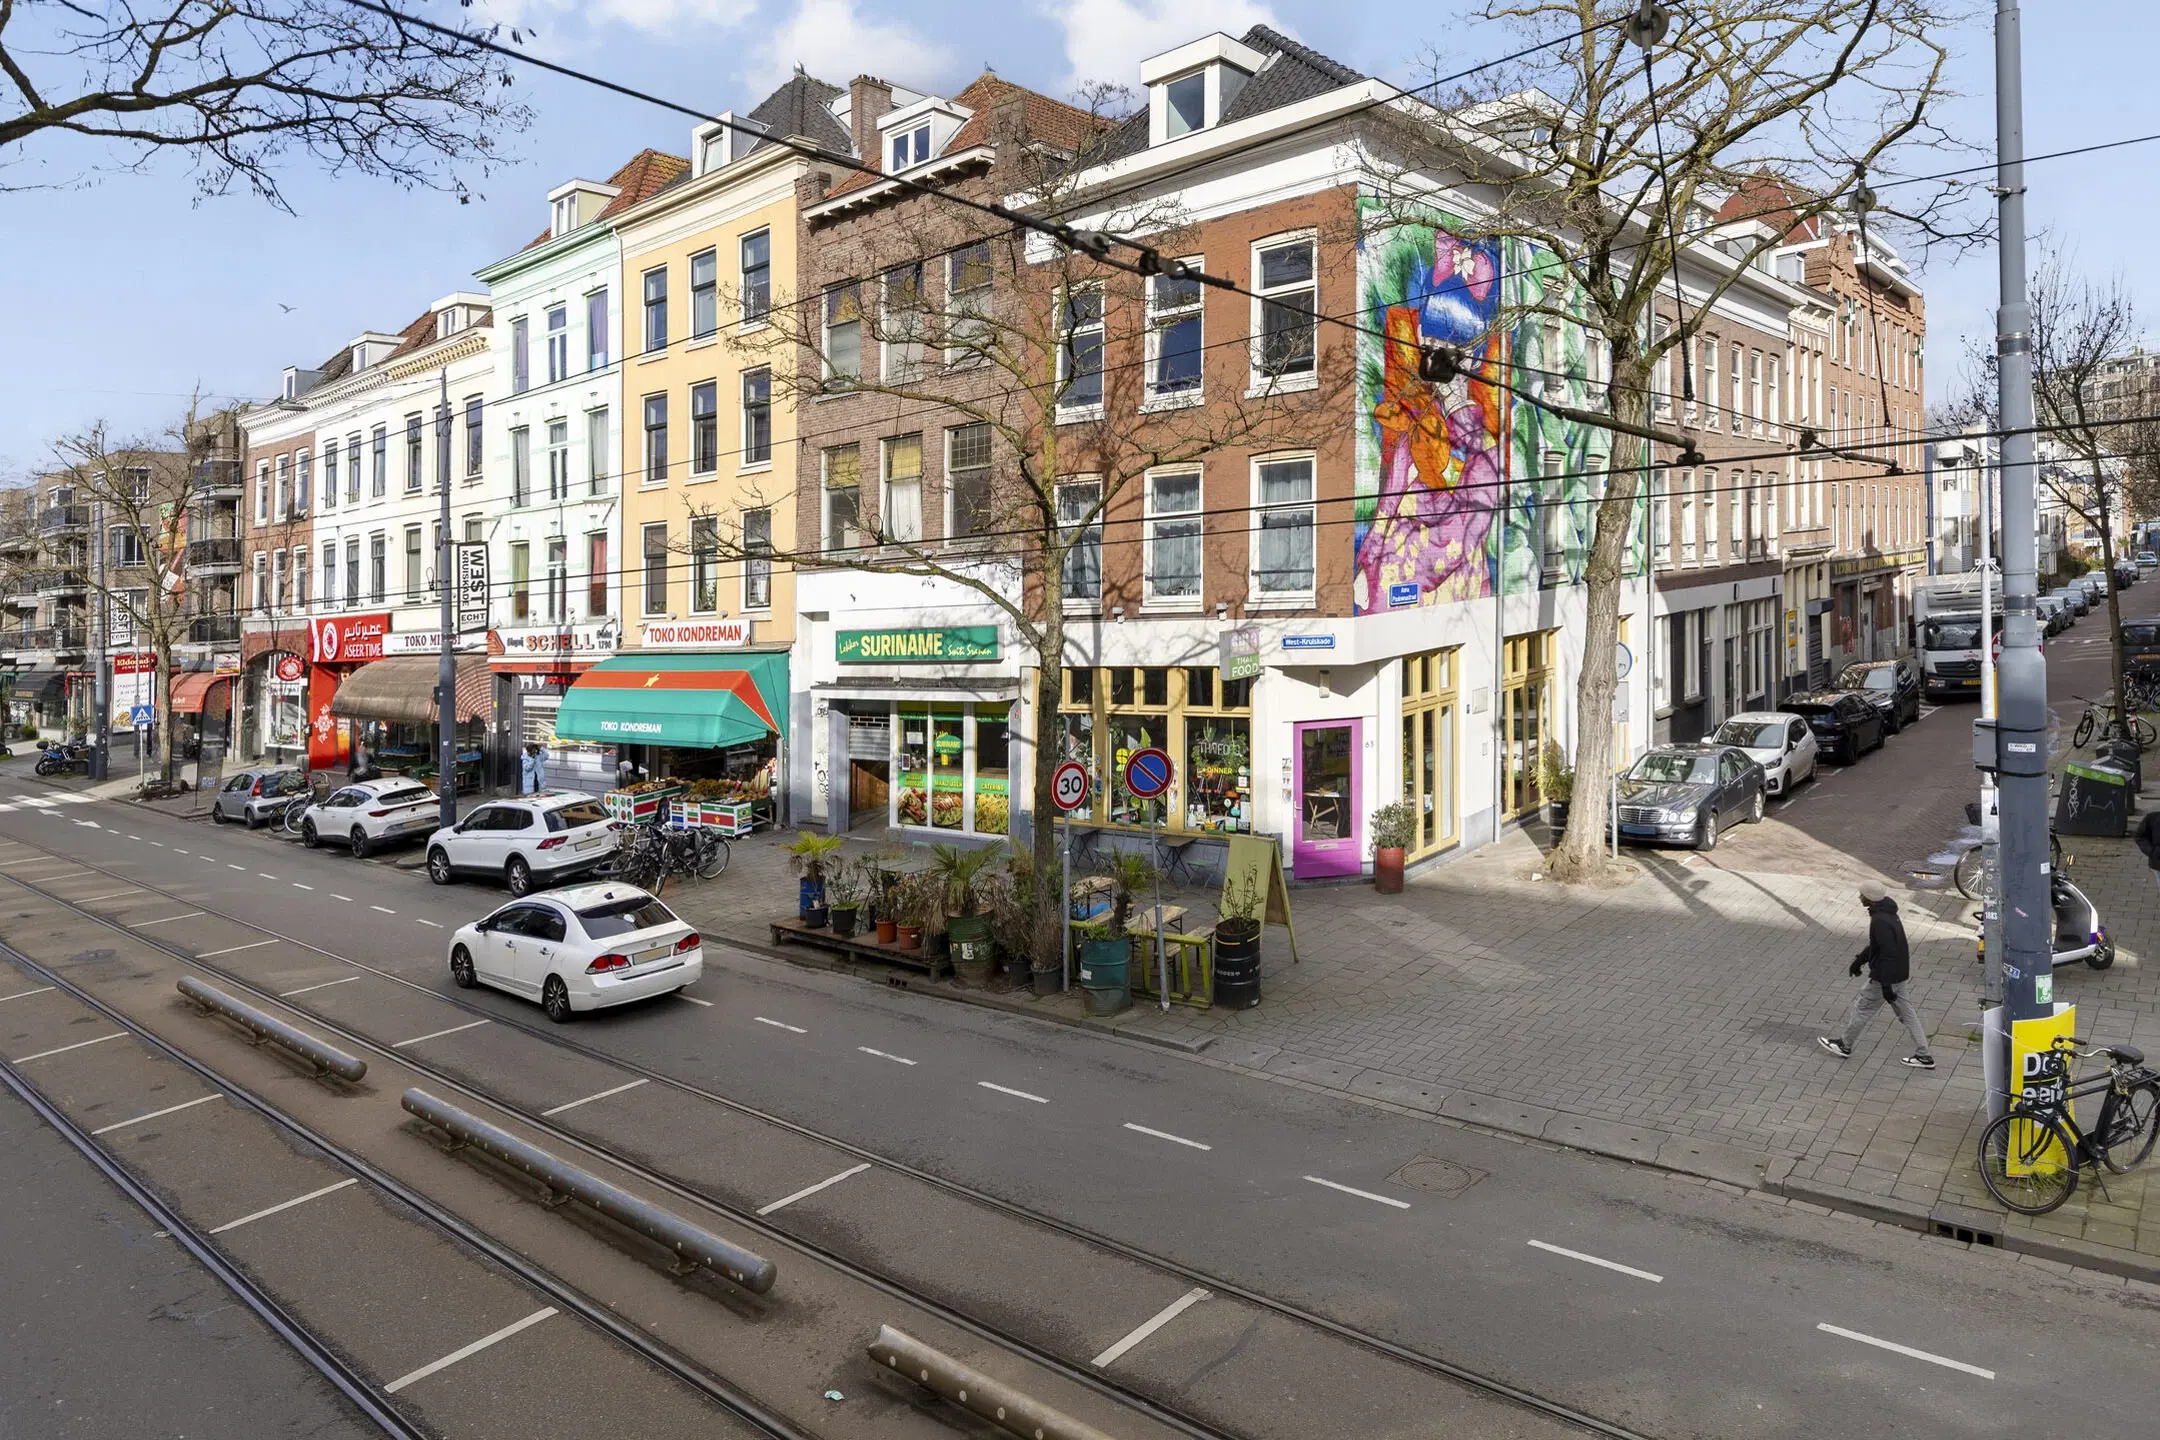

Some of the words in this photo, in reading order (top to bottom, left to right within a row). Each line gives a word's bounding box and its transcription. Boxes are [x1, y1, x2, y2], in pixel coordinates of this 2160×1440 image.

[462, 550, 470, 606] KRUISKADE
[461, 612, 485, 621] ECHT
[404, 635, 427, 647] TOKO
[649, 627, 675, 643] TOKO
[677, 625, 742, 642] KONDREMAN
[526, 633, 595, 651] SCHELL
[861, 632, 944, 657] SURINAME
[1285, 638, 1331, 646] West-Kruiskade
[344, 644, 364, 658] ASEER
[365, 643, 382, 656] TIME
[1236, 656, 1253, 665] THAI
[1231, 663, 1259, 677] FOOD
[601, 721, 619, 732] TOKO
[620, 721, 662, 733] KONDREMAN
[1059, 775, 1082, 795] 30
